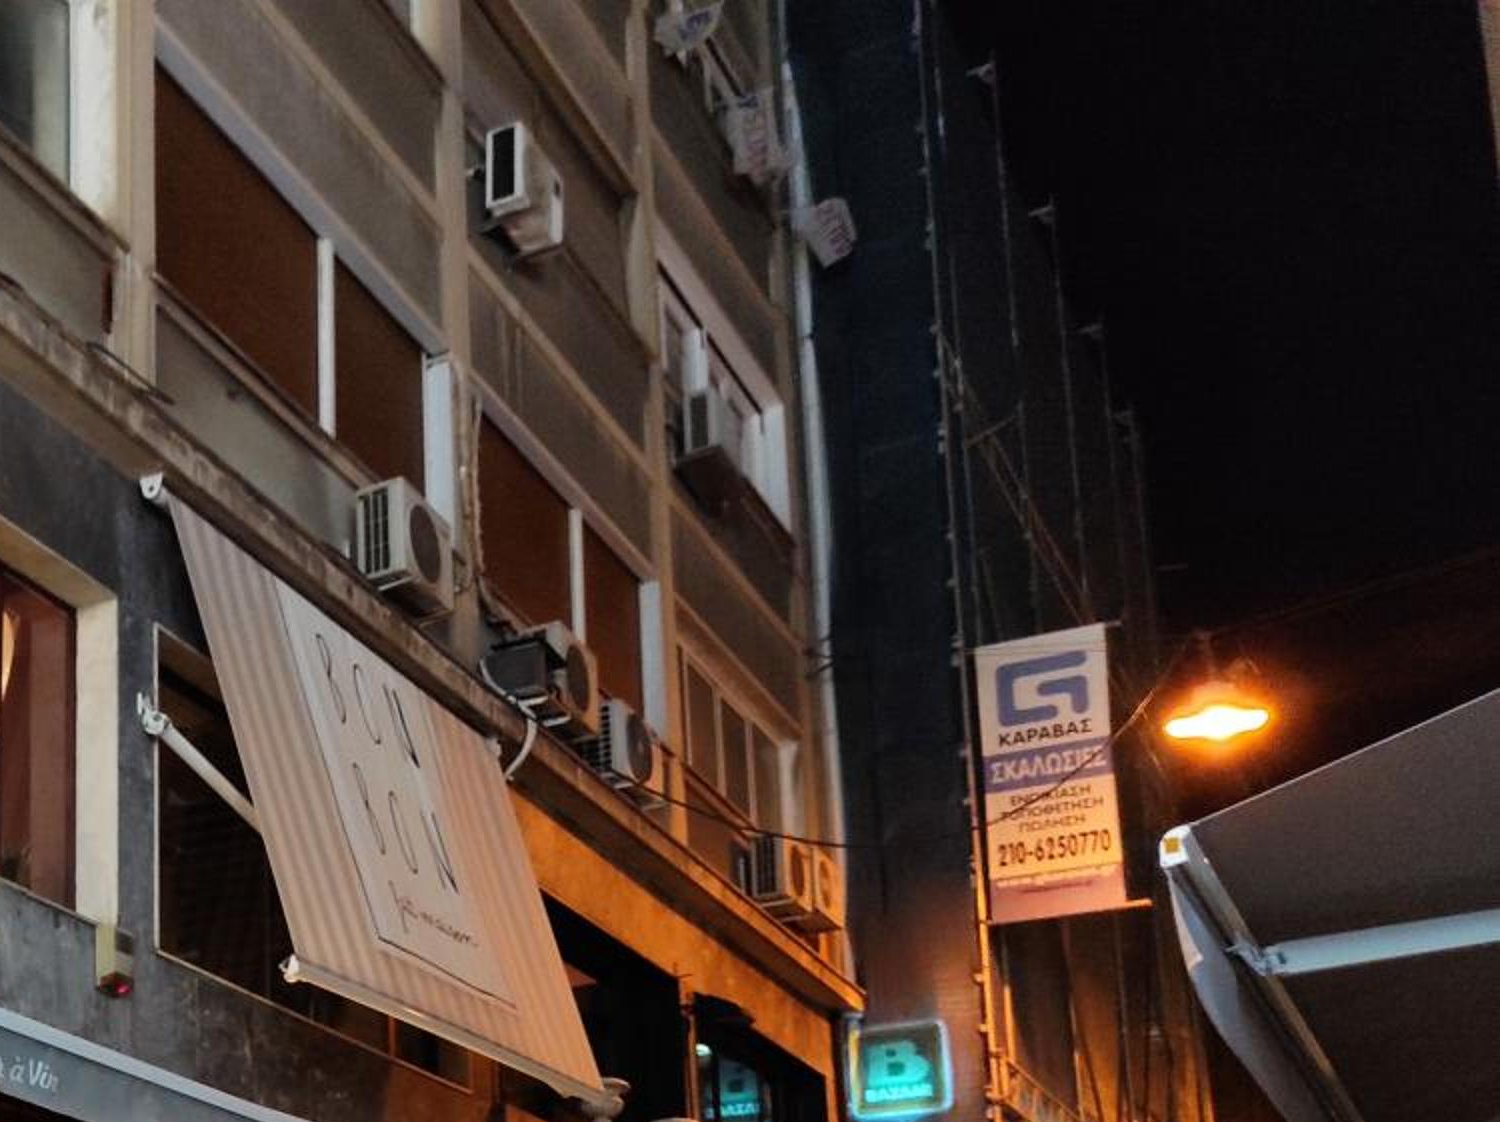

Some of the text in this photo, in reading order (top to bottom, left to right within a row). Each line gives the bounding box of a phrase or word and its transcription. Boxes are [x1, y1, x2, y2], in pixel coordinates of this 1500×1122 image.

[998, 718, 1093, 748] ΚΑΡΑΒΑΣ
[998, 829, 1112, 867] 210-6250770
[28, 1059, 60, 1092] Vin
[867, 1041, 932, 1089] B
